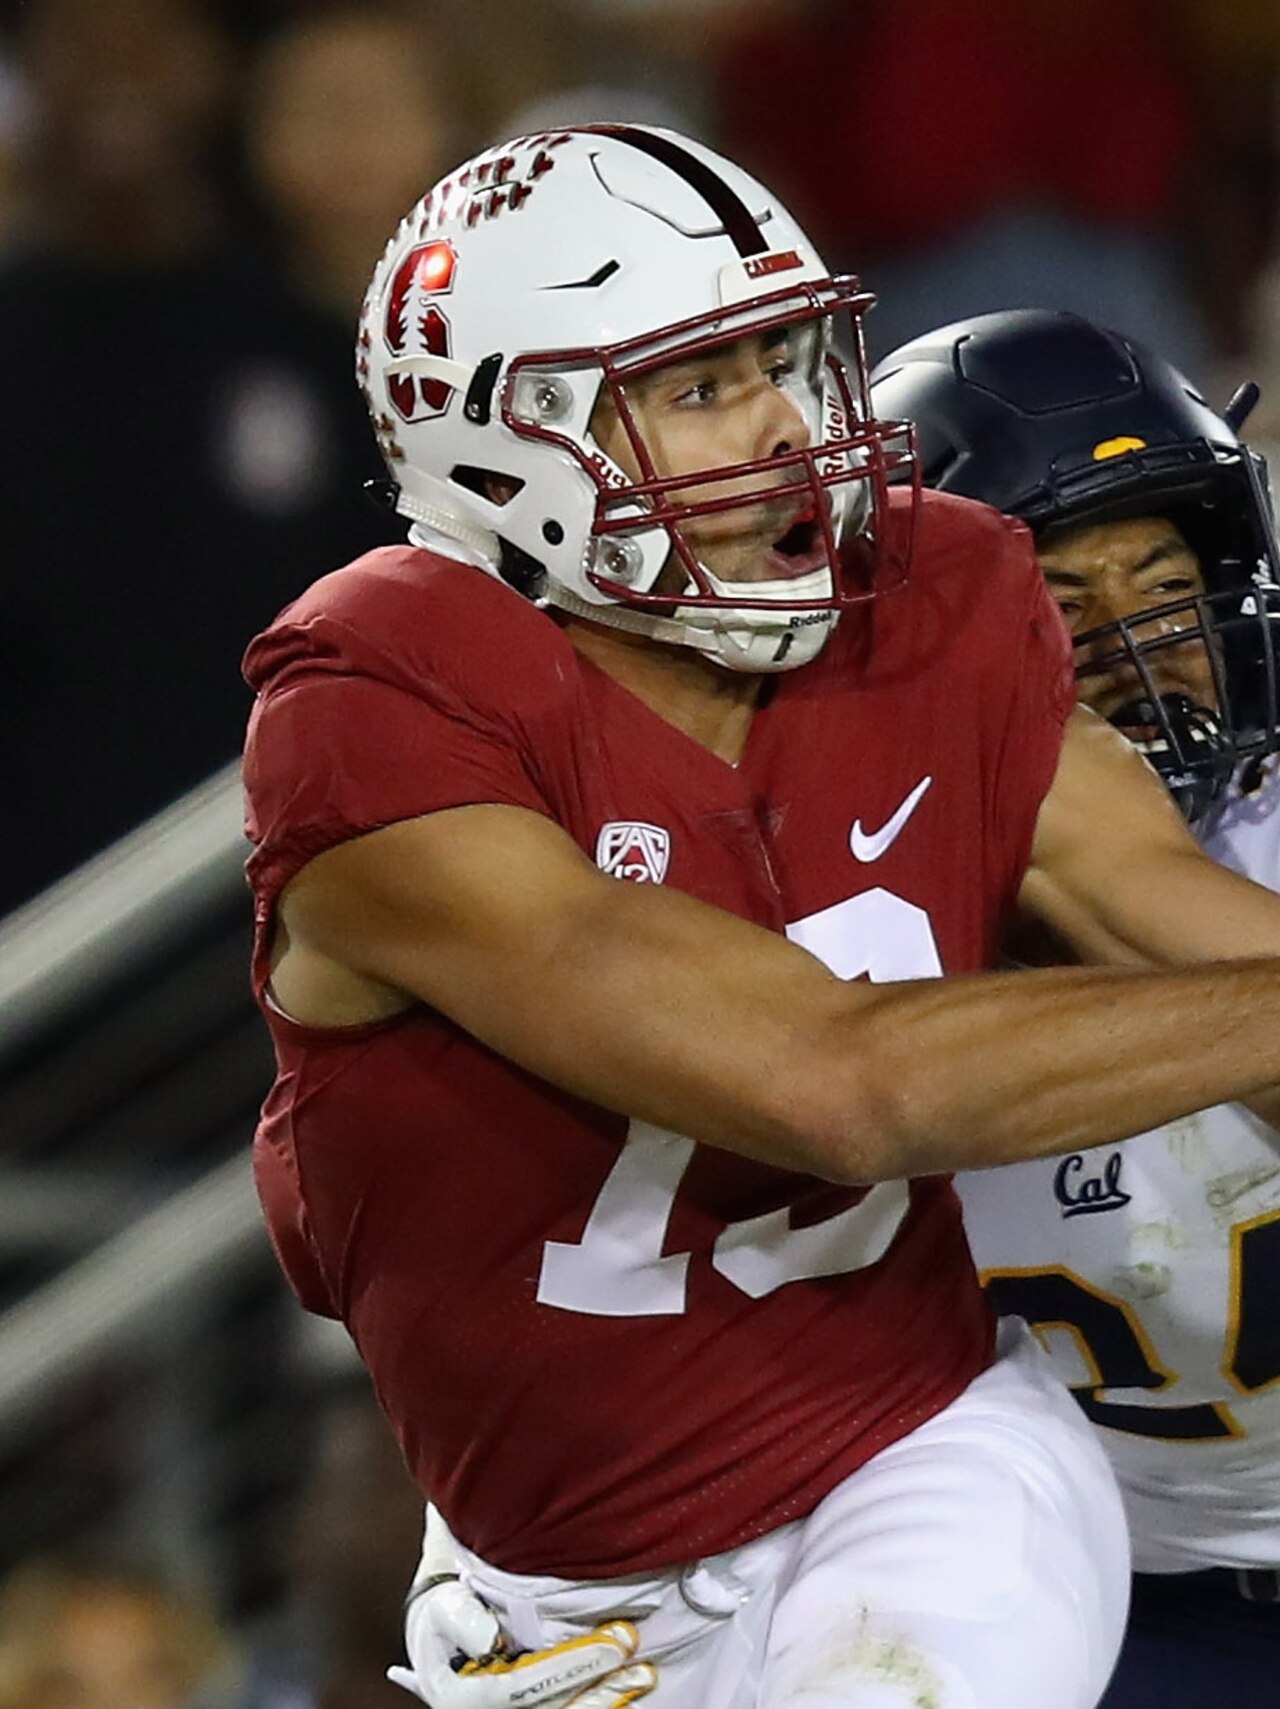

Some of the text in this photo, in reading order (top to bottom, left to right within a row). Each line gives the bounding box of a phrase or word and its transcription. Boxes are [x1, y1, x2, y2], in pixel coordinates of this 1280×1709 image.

[824, 393, 844, 476] Ridell
[600, 827, 666, 882] PAC
[1054, 1151, 1131, 1219] Cal
